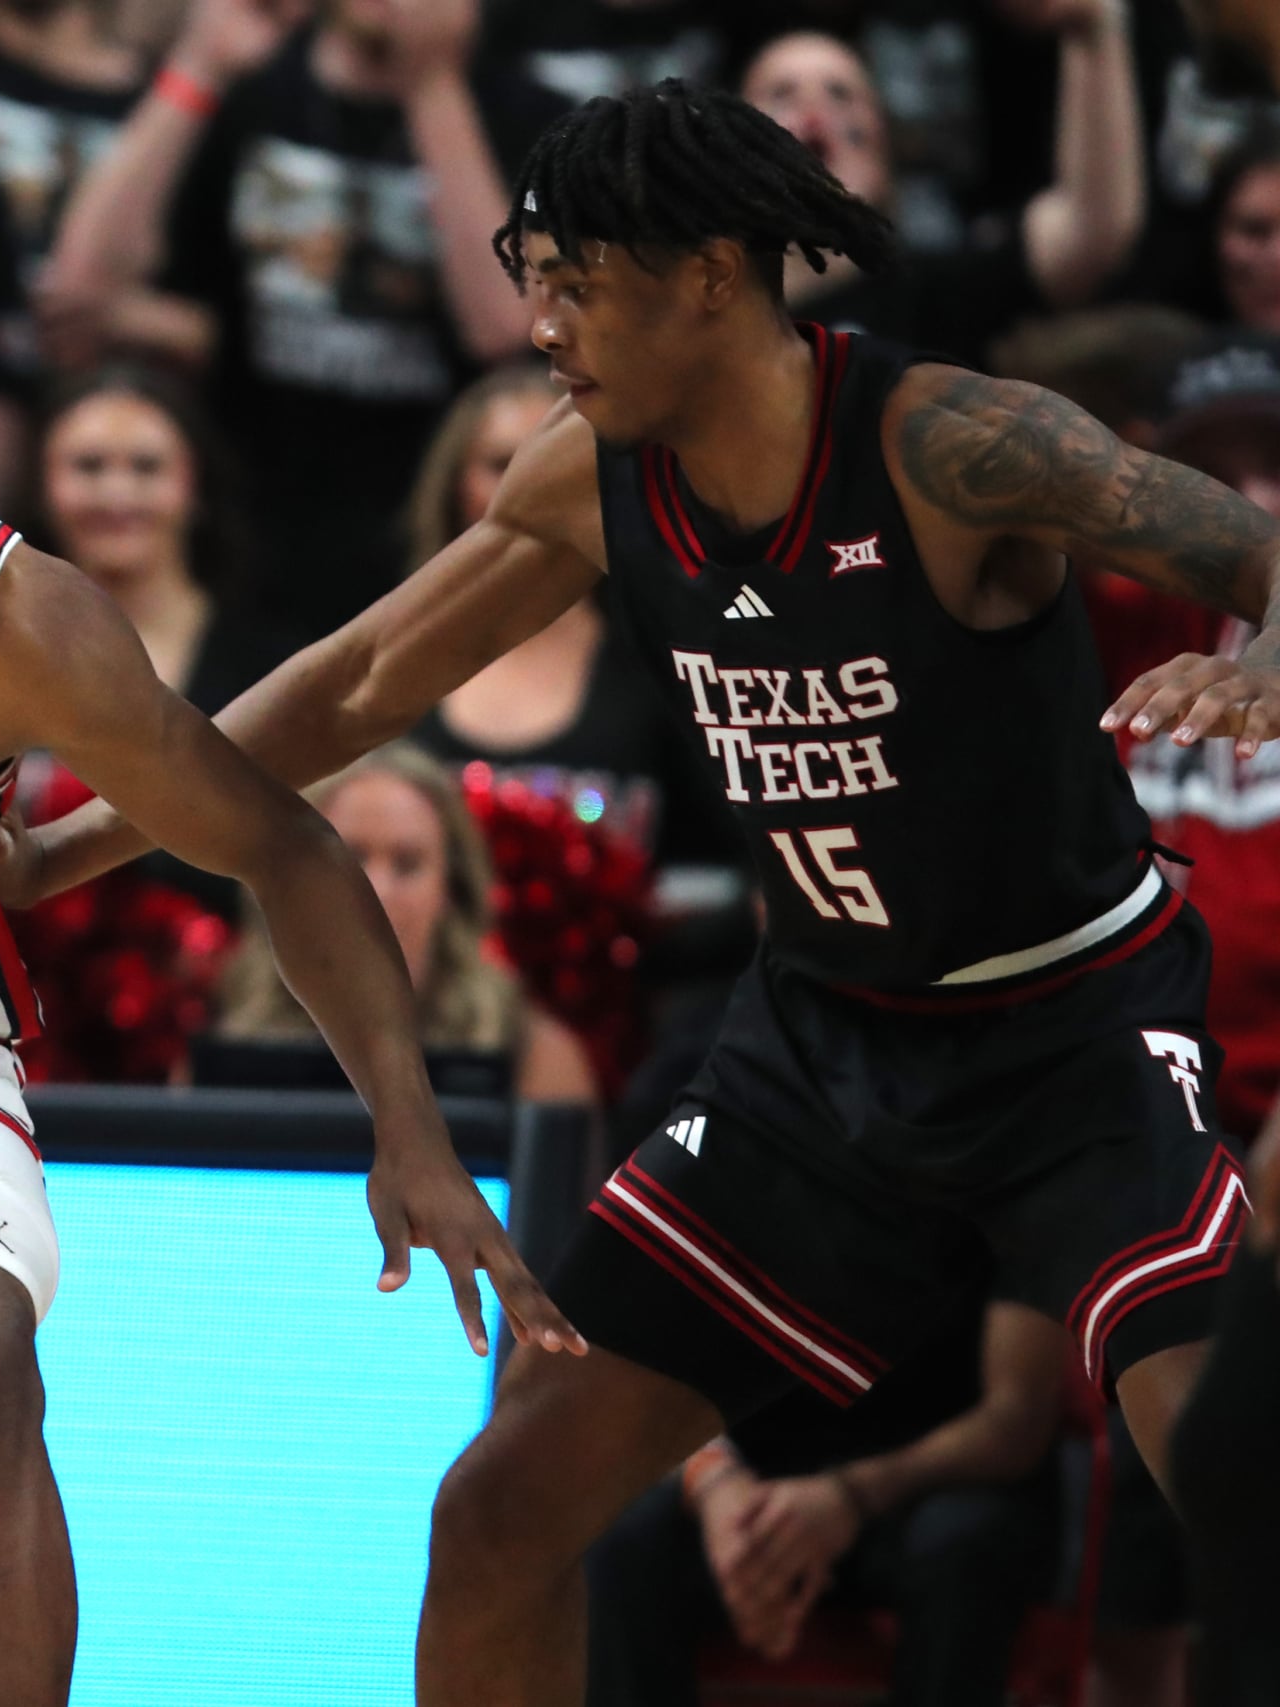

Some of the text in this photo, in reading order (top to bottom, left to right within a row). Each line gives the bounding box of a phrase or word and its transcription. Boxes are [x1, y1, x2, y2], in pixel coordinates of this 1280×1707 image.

[829, 536, 883, 573] XII
[671, 648, 900, 727] TEXAS
[703, 725, 900, 803] TECH
[768, 826, 891, 927] 15
